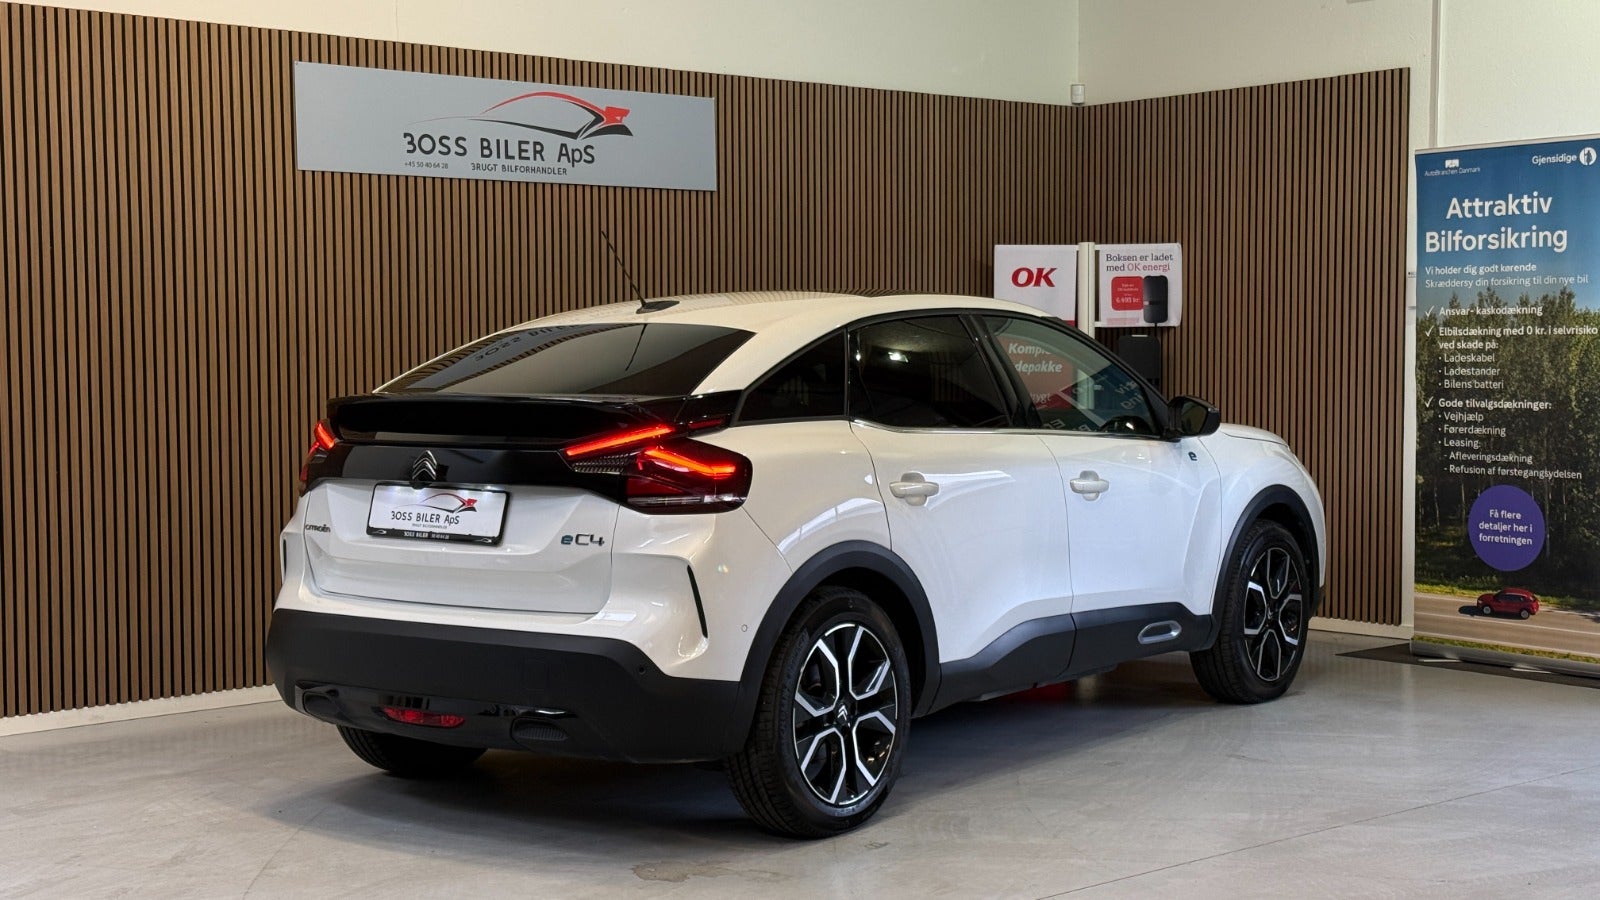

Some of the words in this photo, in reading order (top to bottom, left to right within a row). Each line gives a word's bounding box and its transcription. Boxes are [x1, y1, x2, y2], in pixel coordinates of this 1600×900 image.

[480, 137, 545, 162] BILER
[557, 143, 595, 168] ApS
[1532, 153, 1577, 165] Gjensidige
[501, 164, 567, 176] BILFORHANDLER
[1446, 191, 1553, 219] Attraktiv
[1425, 225, 1568, 253] Bilforsikring
[1106, 254, 1138, 262] Boksen
[1151, 254, 1173, 262] ladet
[1106, 264, 1125, 272] med
[1127, 263, 1141, 271] OK
[1142, 262, 1171, 273] energi
[1425, 266, 1434, 275] Vi
[1435, 266, 1461, 275] holder
[1463, 264, 1478, 276] dig
[1479, 264, 1499, 275] godt
[1500, 263, 1537, 272] kørende
[1011, 267, 1057, 288] OK
[1425, 279, 1473, 289] Skræddersy
[1475, 278, 1489, 287] din
[1491, 276, 1531, 287] forsikring
[1533, 275, 1542, 285] til
[1543, 275, 1557, 285] din
[1559, 276, 1575, 286] nye
[1577, 274, 1589, 284] bil
[1476, 305, 1543, 317] kaskodækning
[1439, 326, 1502, 338] Elbilsdækning
[1503, 326, 1525, 336] med
[1526, 325, 1533, 335] 0
[1535, 326, 1547, 335] kr.
[1553, 325, 1599, 335] selvrisiko
[1439, 340, 1455, 350] ved
[1457, 340, 1483, 349] skade
[1485, 339, 1499, 351] på:
[1444, 353, 1495, 363] Ladeskabel
[1014, 360, 1063, 375] depakke
[1444, 366, 1500, 376] Ladestander
[1444, 379, 1472, 389] Bilens
[1474, 379, 1504, 389] batteri
[1438, 398, 1463, 408] Gode
[1465, 399, 1552, 411] tilvalgsdækninger:
[1444, 412, 1484, 422] Vejhjælp
[1443, 424, 1506, 437] Førerdækning
[1188, 451, 1198, 462] e
[1449, 451, 1533, 465] Afleveringsdækning
[1449, 464, 1486, 475] Refusion
[1487, 466, 1496, 475] af
[1498, 467, 1583, 480] førstegangsydelsen
[416, 512, 441, 524] BILER
[444, 514, 460, 526] ApS
[1489, 509, 1499, 518] Få
[1501, 510, 1522, 520] flere
[1478, 521, 1512, 533] detaljer
[1513, 523, 1529, 533] her
[560, 533, 605, 547] eC4
[1478, 532, 1533, 547] forretningen
